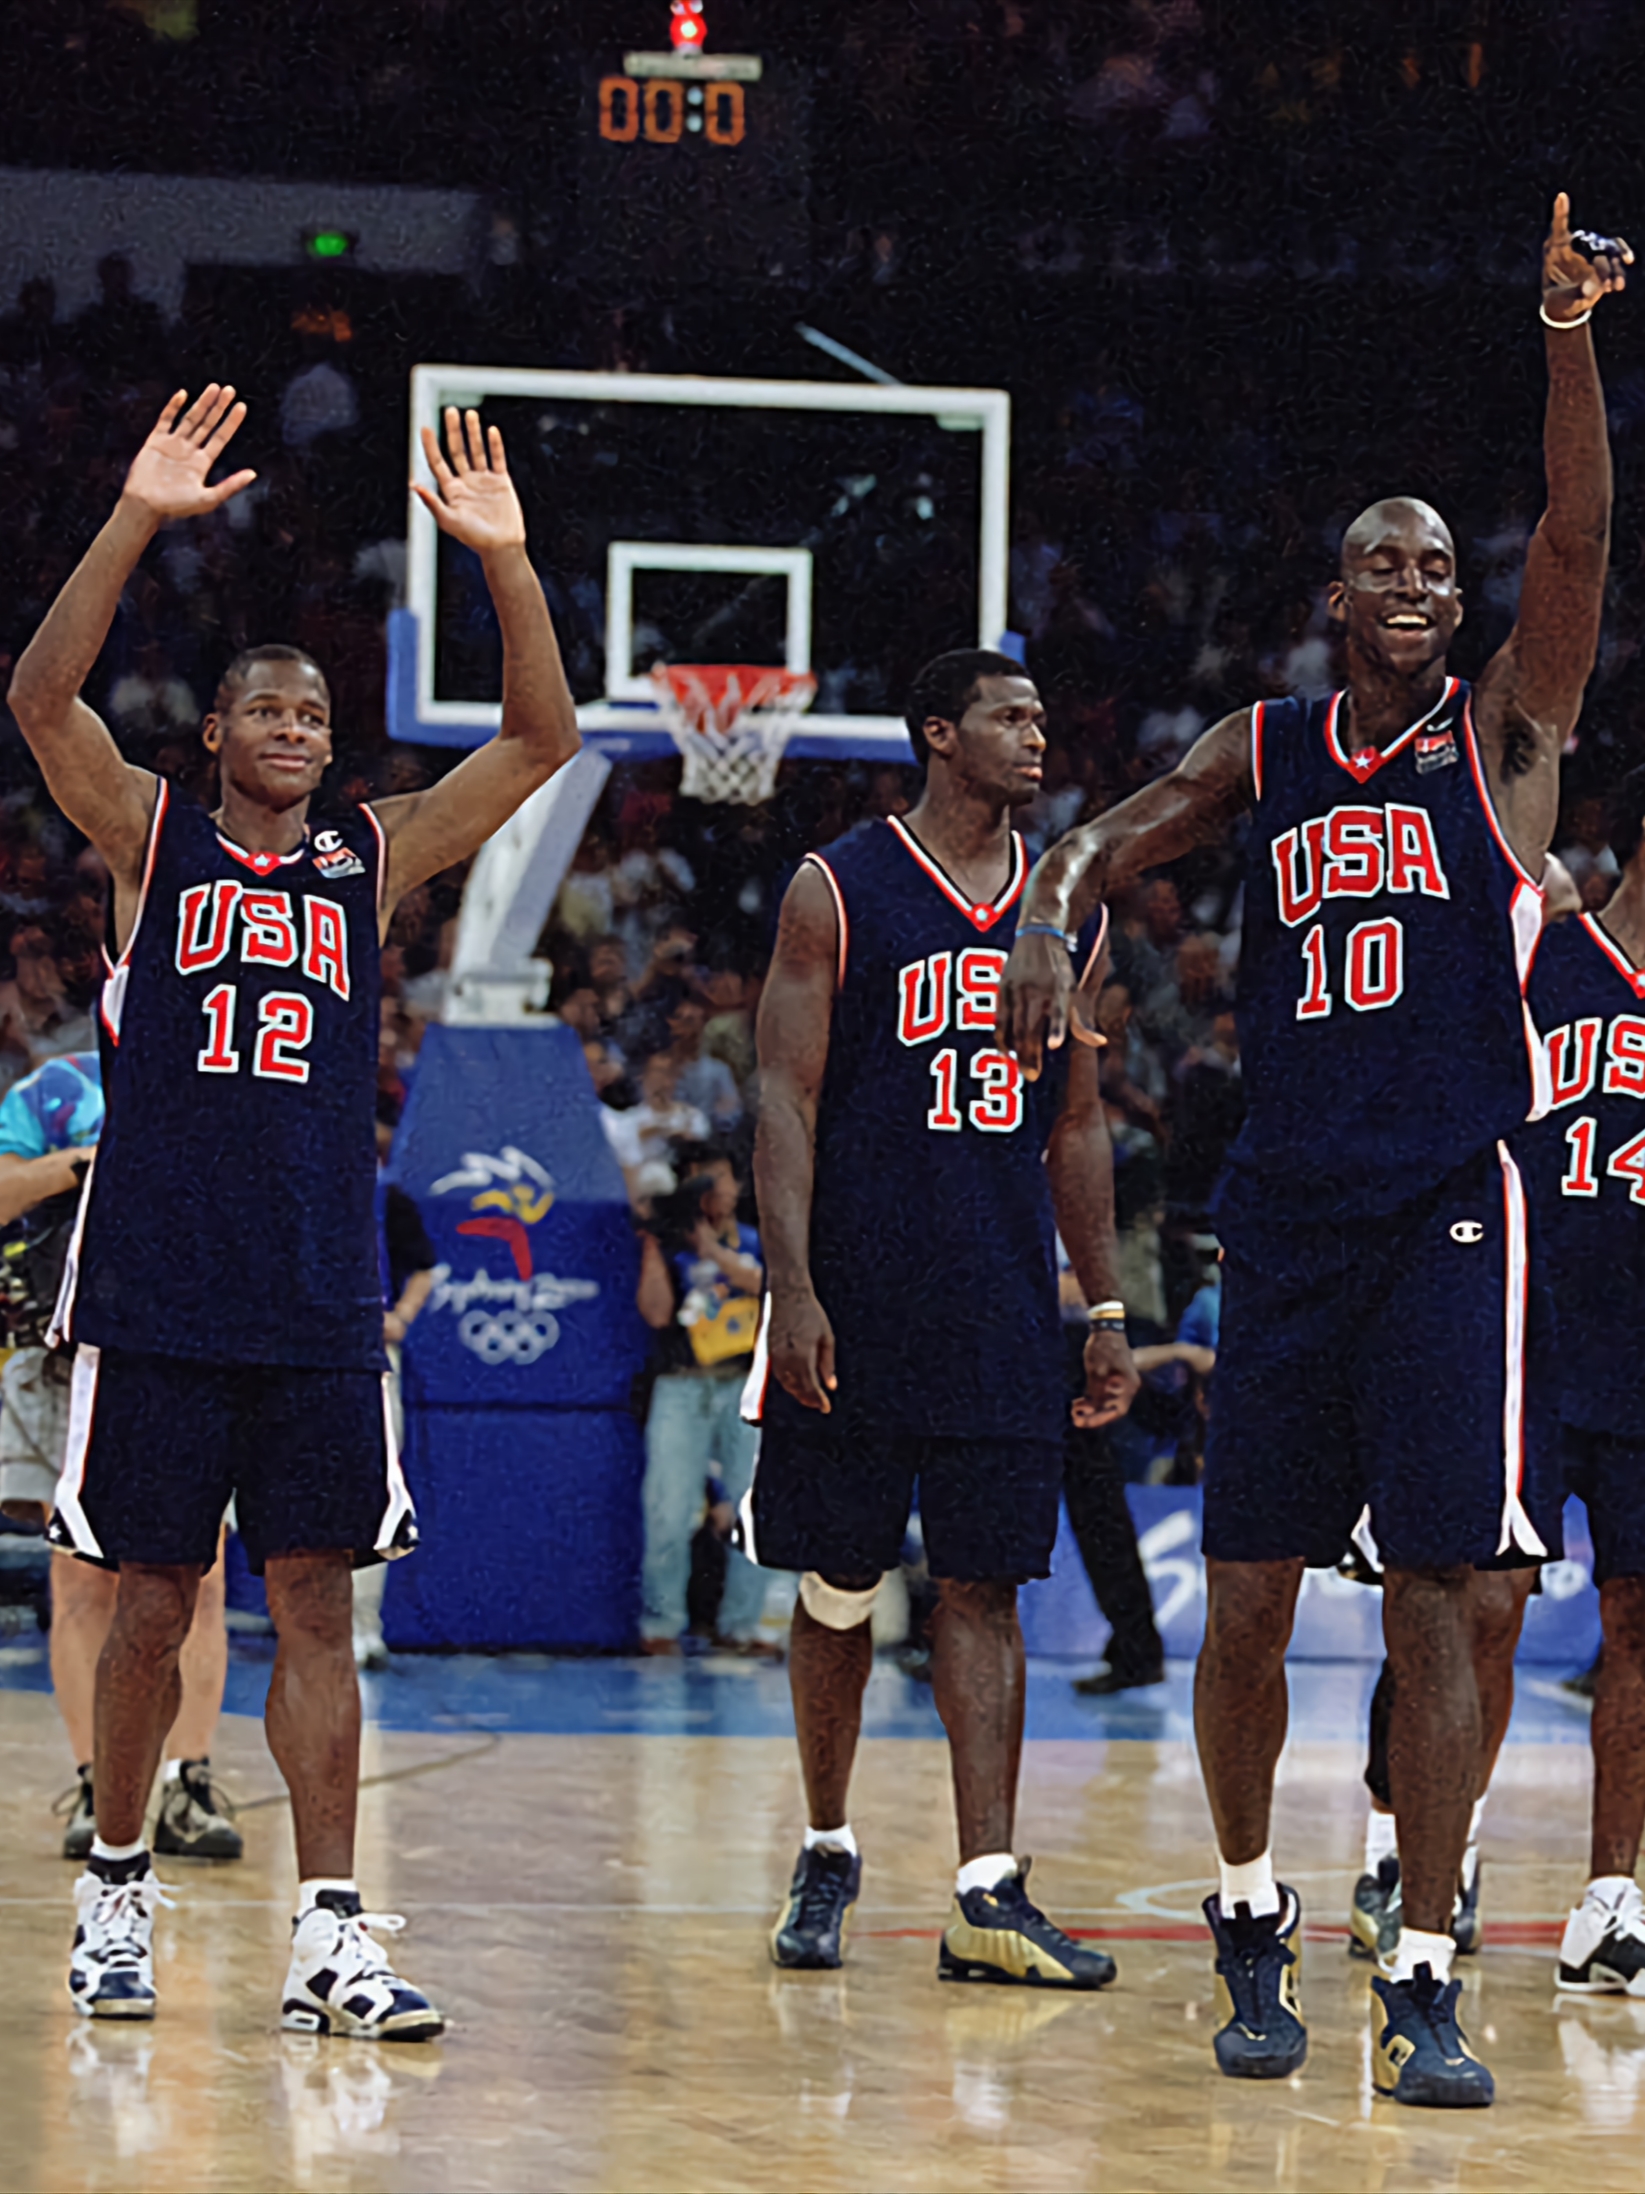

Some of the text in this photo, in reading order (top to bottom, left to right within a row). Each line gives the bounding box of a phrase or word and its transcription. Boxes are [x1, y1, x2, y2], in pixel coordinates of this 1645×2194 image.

[599, 77, 746, 146] 00:0
[1271, 802, 1450, 928] USA
[175, 880, 350, 1002] USA
[1296, 917, 1403, 1020] 10
[197, 984, 313, 1084] 12
[897, 947, 1009, 1047] US
[928, 1048, 1024, 1133] 13
[1543, 1013, 1645, 1110] US
[1561, 1116, 1645, 1206] 14
